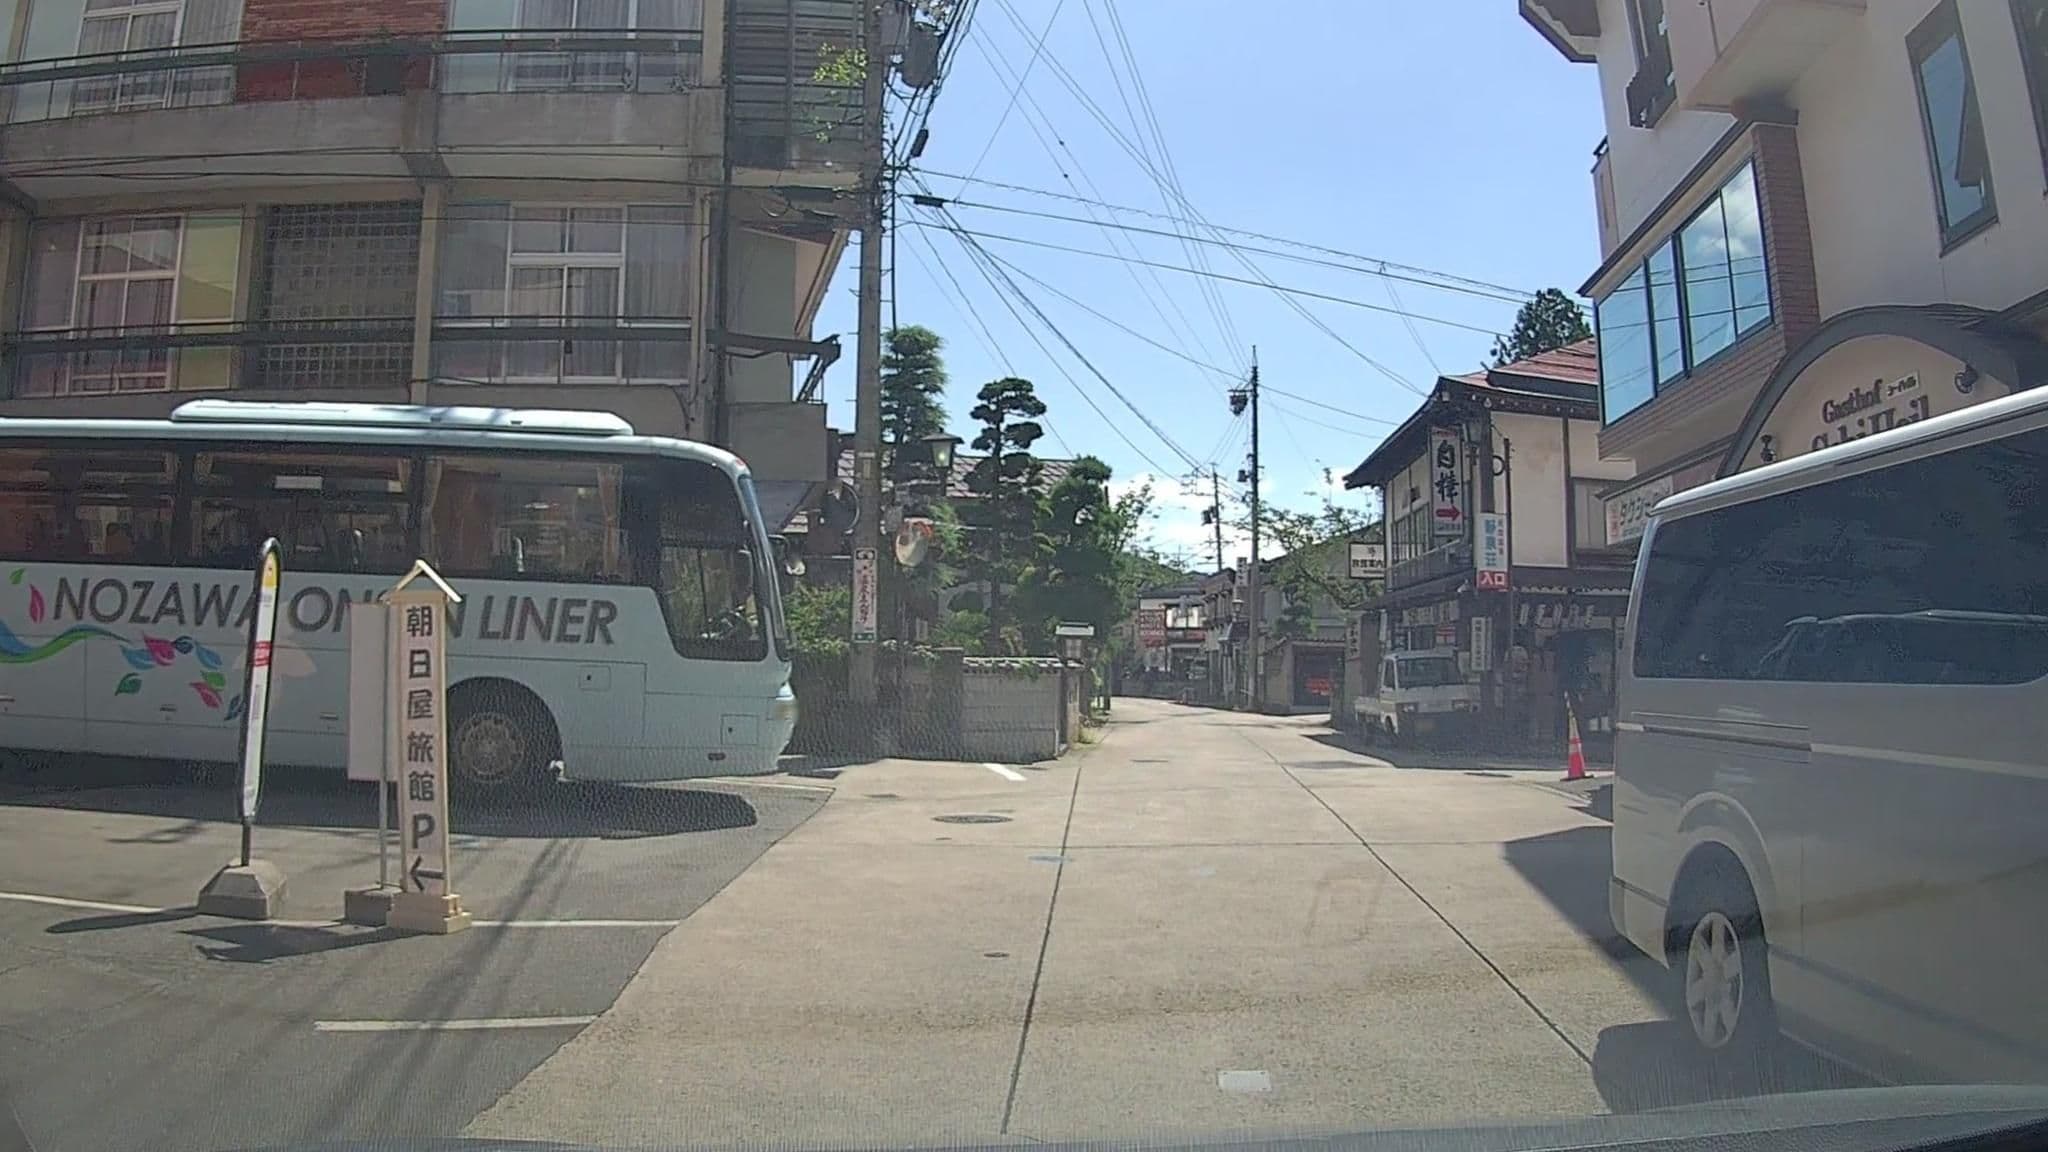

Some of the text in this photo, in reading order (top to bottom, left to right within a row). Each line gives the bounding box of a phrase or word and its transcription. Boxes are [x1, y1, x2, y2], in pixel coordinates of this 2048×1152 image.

[1822, 378, 1883, 424] Gasthof
[1481, 571, 1505, 586] 入口
[287, 586, 466, 639] ONN
[478, 594, 618, 646] LINER
